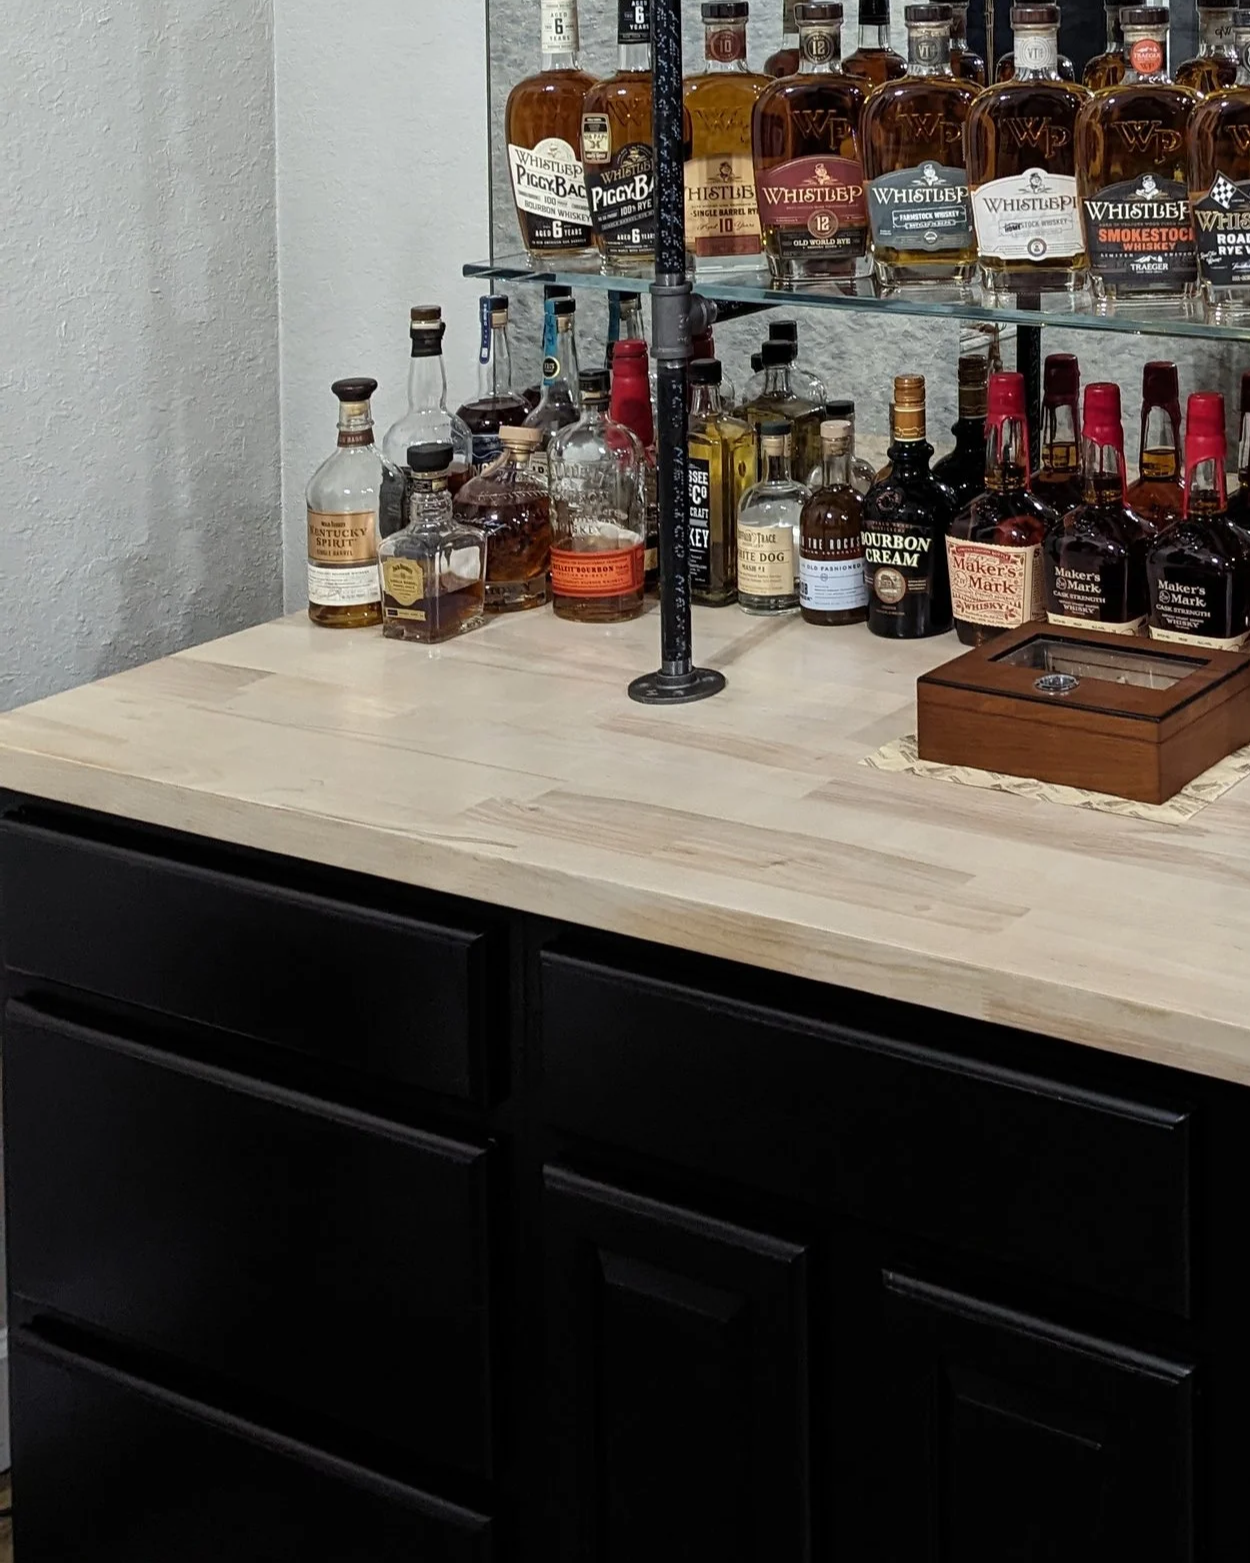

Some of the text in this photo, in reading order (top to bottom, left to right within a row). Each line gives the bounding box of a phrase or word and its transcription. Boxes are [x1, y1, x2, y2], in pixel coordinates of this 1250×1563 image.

[635, 6, 645, 24] 6
[554, 18, 563, 35] 6
[524, 200, 592, 223] BOURBON WHISKEY
[637, 199, 652, 211] RYE
[693, 207, 746, 217] SINGLE BARREL
[899, 210, 960, 221] FARMSTOCK WHISKEY
[1041, 218, 1068, 227] WHISKEY
[535, 221, 582, 238] AGED 6 YEARS
[719, 218, 733, 233] 10
[816, 216, 830, 231] 12
[632, 229, 640, 243] 6
[810, 238, 836, 246] WORLD
[1123, 242, 1178, 251] WHISKEY
[1218, 245, 1242, 255] RYE
[1130, 262, 1168, 271] TRAEGER
[316, 538, 357, 549] SPIRIT
[808, 536, 860, 550] THE ROCKS
[860, 530, 932, 553] BOURBON
[759, 552, 785, 562] DOG
[865, 549, 920, 568] CREAM
[576, 564, 614, 573] BOURBON
[820, 563, 861, 571] FASHIONED
[953, 556, 1016, 578] Maker's
[1054, 566, 1100, 582] Maker's
[969, 575, 1015, 595] Mark
[1067, 580, 1102, 594] Mark
[1157, 579, 1206, 595] Maker's
[1053, 590, 1106, 604] CASK STRENGTH
[1170, 594, 1207, 607] Mark
[963, 600, 1005, 612] WHISKY
[1062, 604, 1095, 614] WHISKY
[1155, 604, 1211, 618] CASK STRENGTH
[1165, 618, 1200, 628] WHISKY
